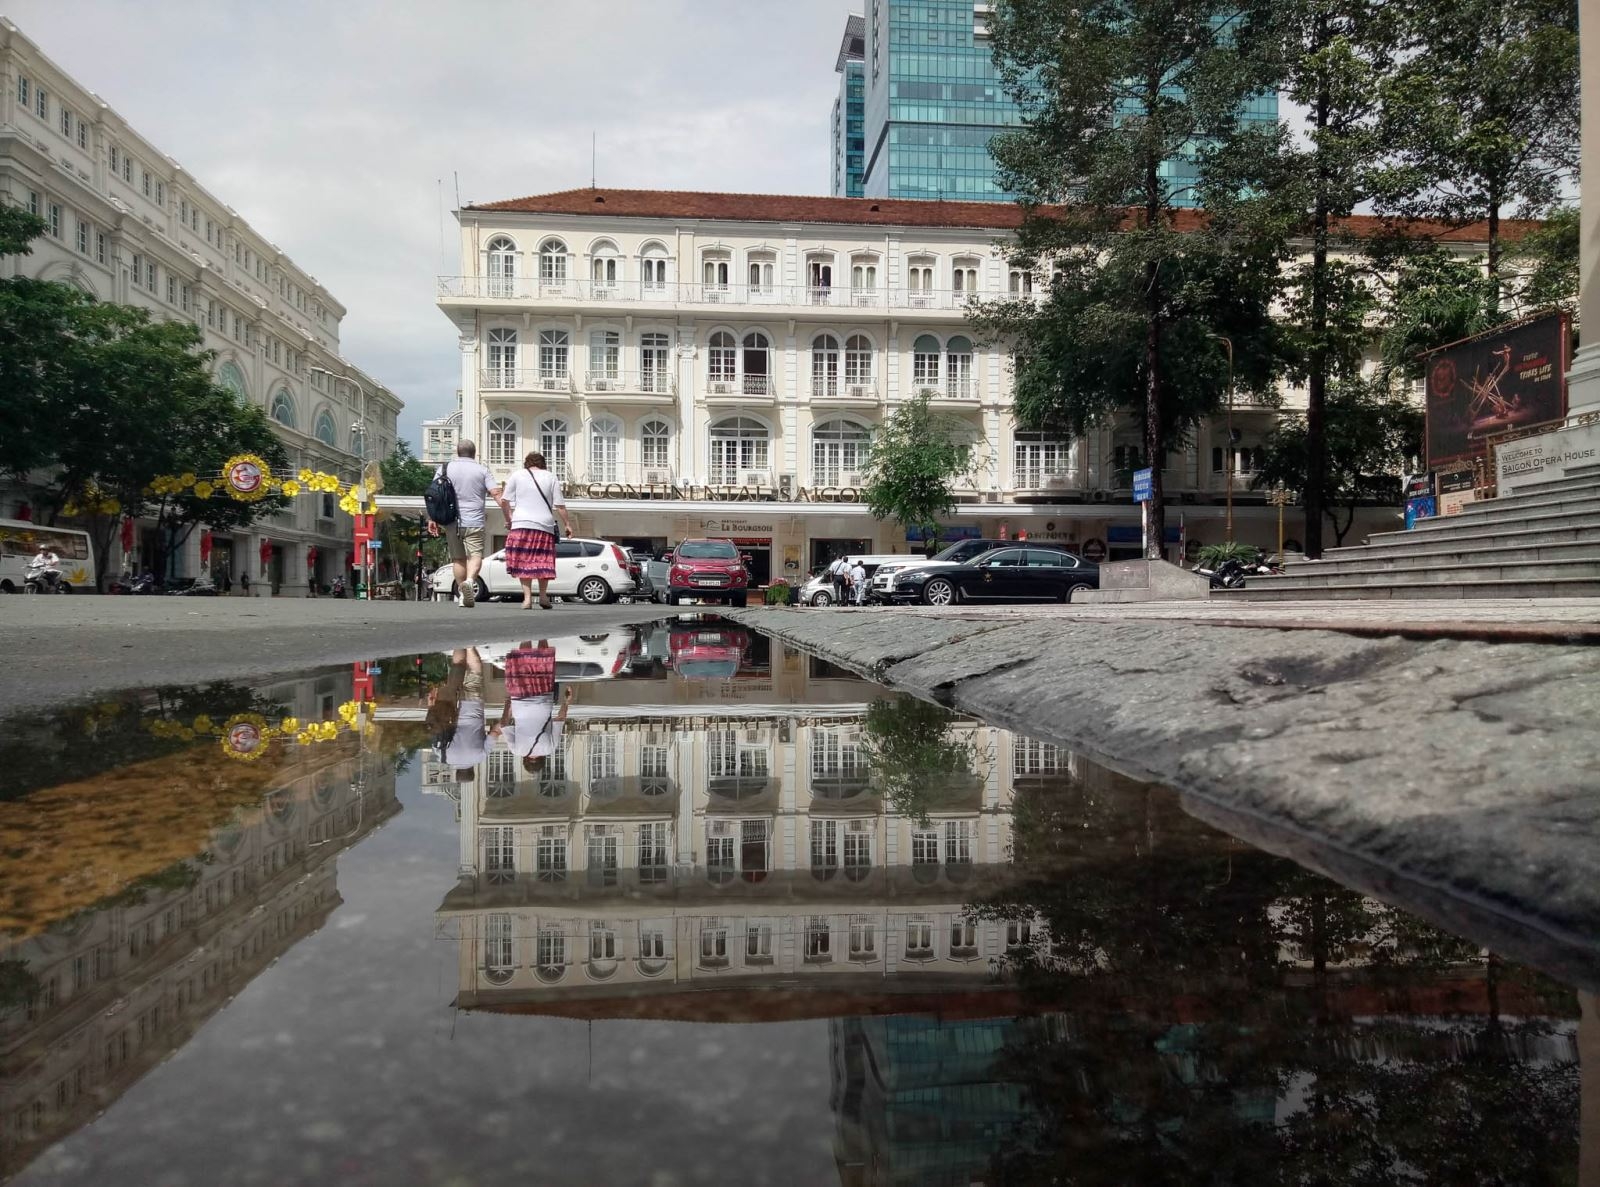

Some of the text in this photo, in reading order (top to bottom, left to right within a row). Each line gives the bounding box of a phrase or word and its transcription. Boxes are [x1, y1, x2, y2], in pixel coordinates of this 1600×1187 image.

[1502, 449, 1533, 462] WELCOME
[1502, 449, 1596, 474] SAIGON OPERA HOUSE
[586, 482, 768, 502] CONTINENTAL
